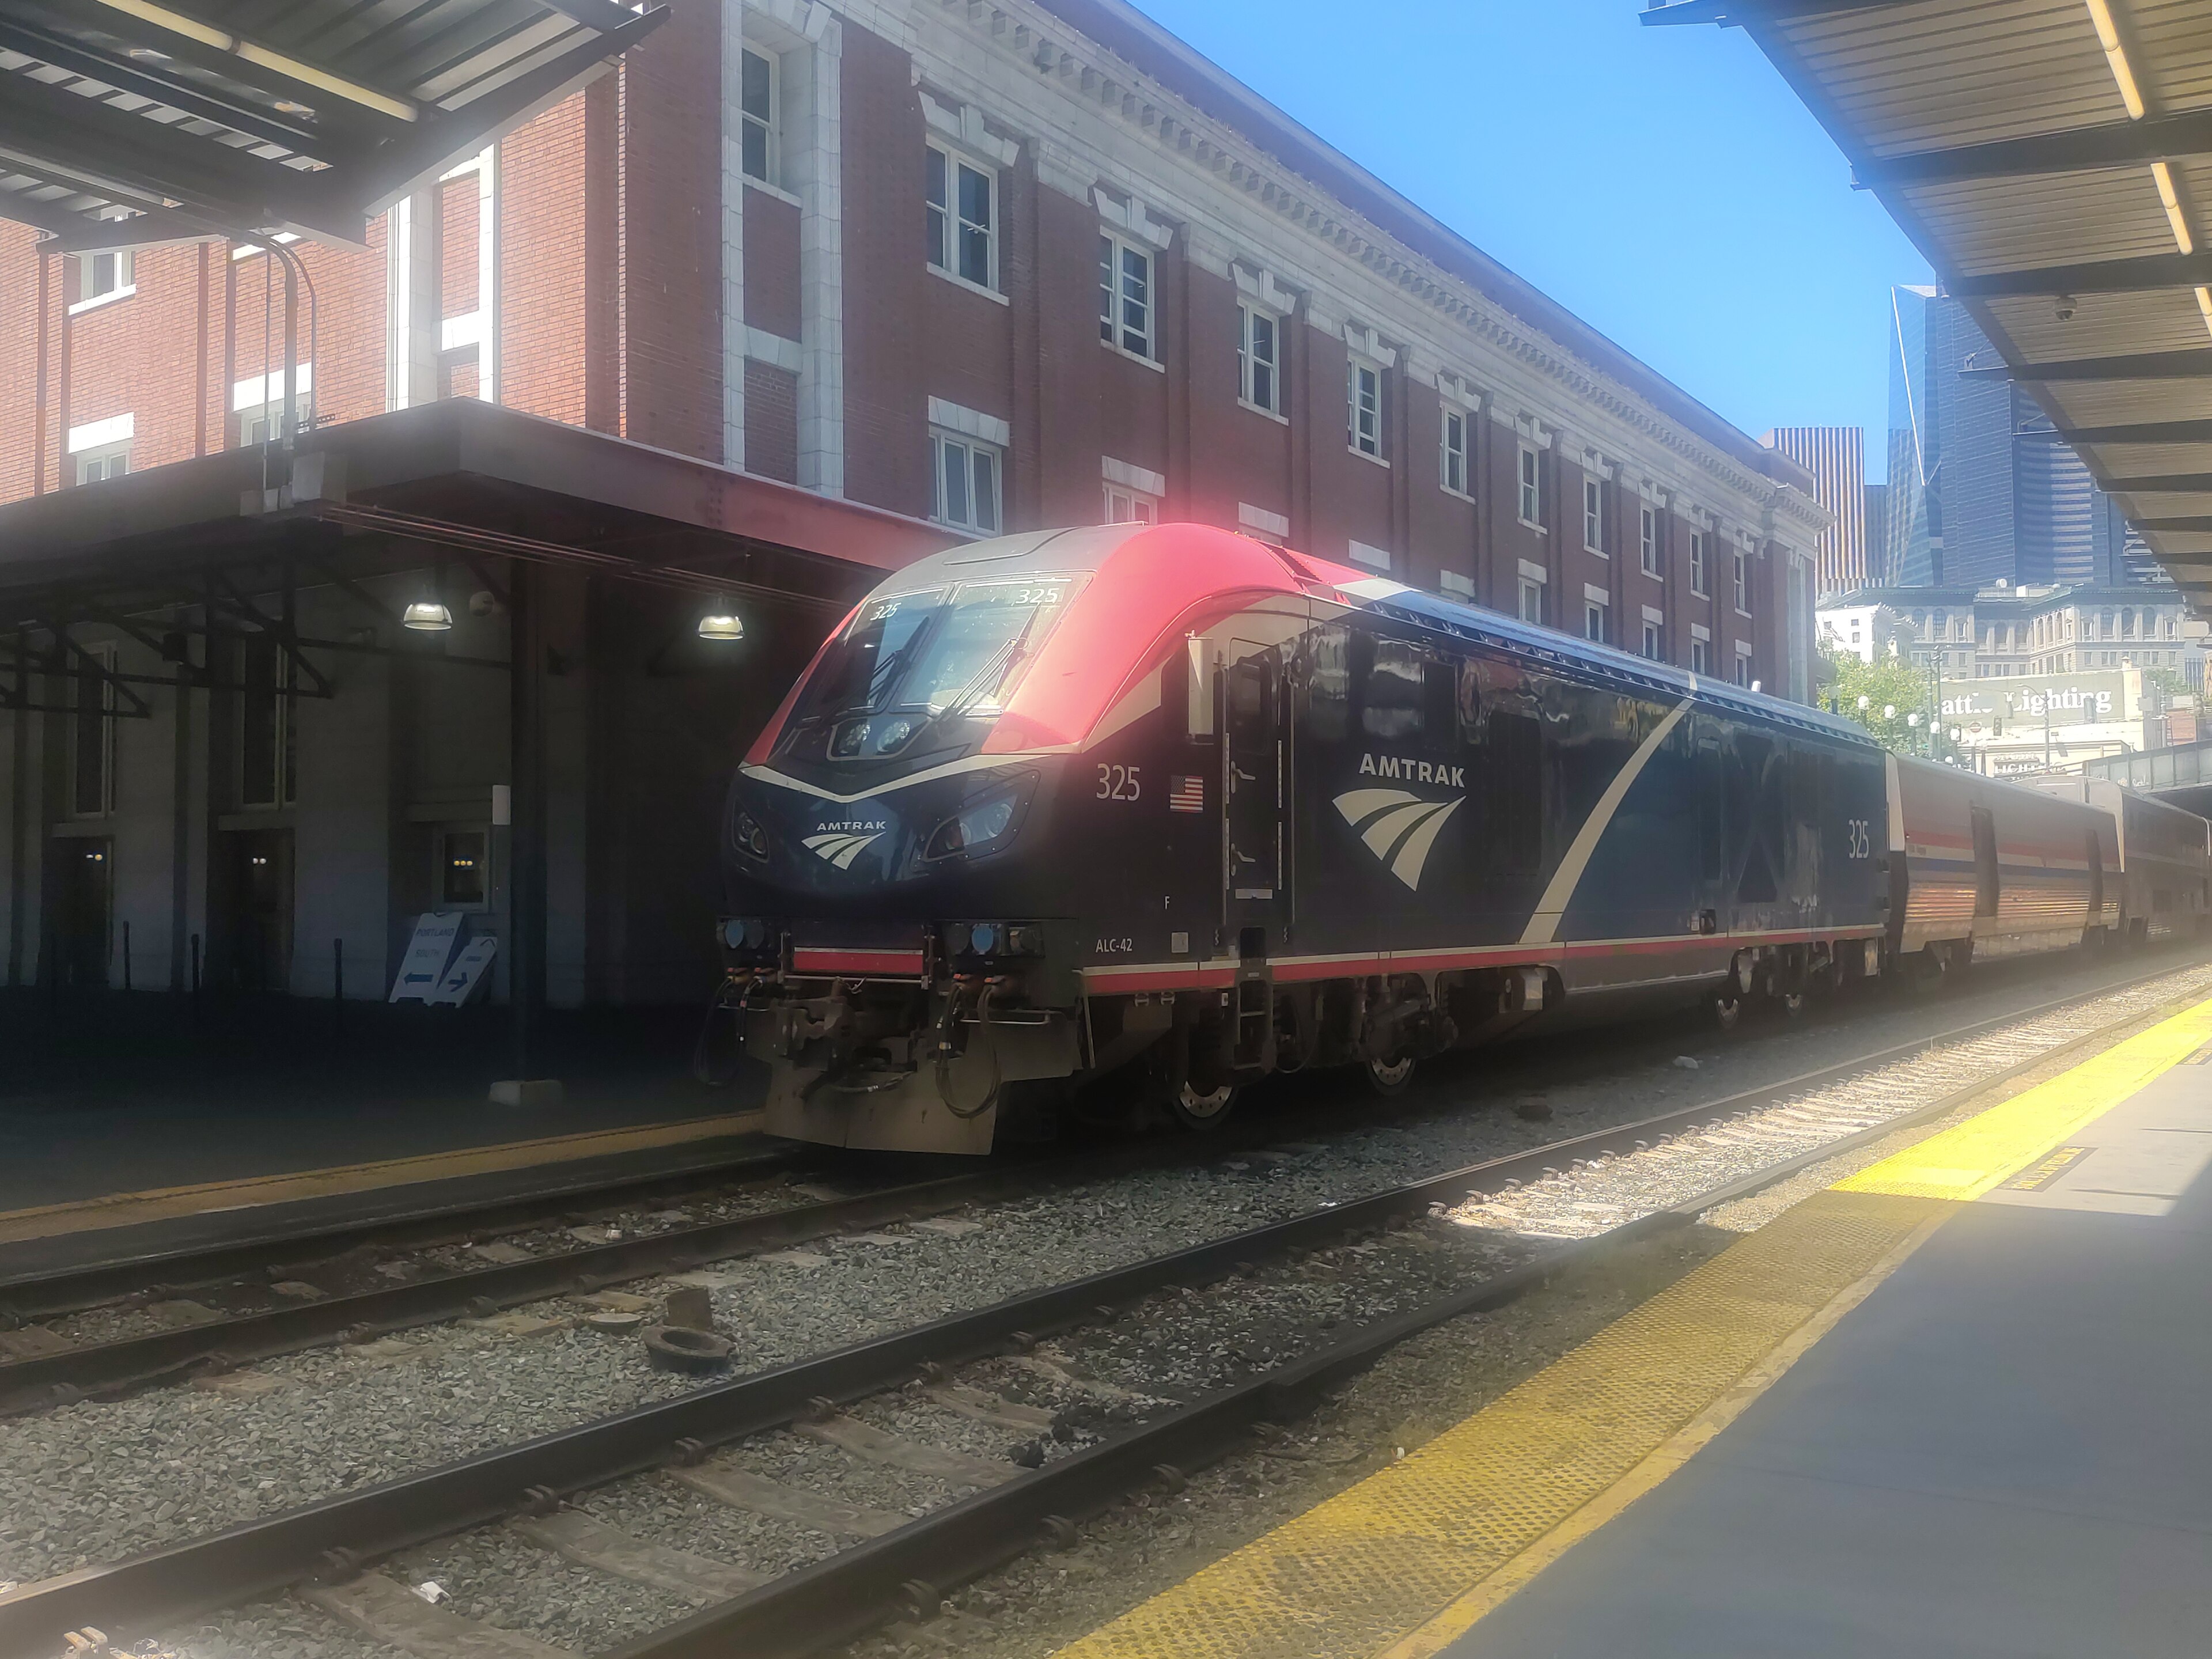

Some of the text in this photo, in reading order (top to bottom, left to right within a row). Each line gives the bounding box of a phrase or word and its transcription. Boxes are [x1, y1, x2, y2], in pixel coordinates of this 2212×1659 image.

[1016, 588, 1059, 604] 325
[870, 602, 902, 620] 325
[1358, 753, 1465, 789] AMTRAK
[1096, 763, 1141, 801] 325
[816, 821, 887, 831] AMTRAK
[1849, 819, 1869, 858] 325
[1165, 896, 1170, 910] F
[415, 927, 454, 937] PORTLAND
[1095, 938, 1132, 953] ALC-42
[415, 949, 440, 958] SOUTH
